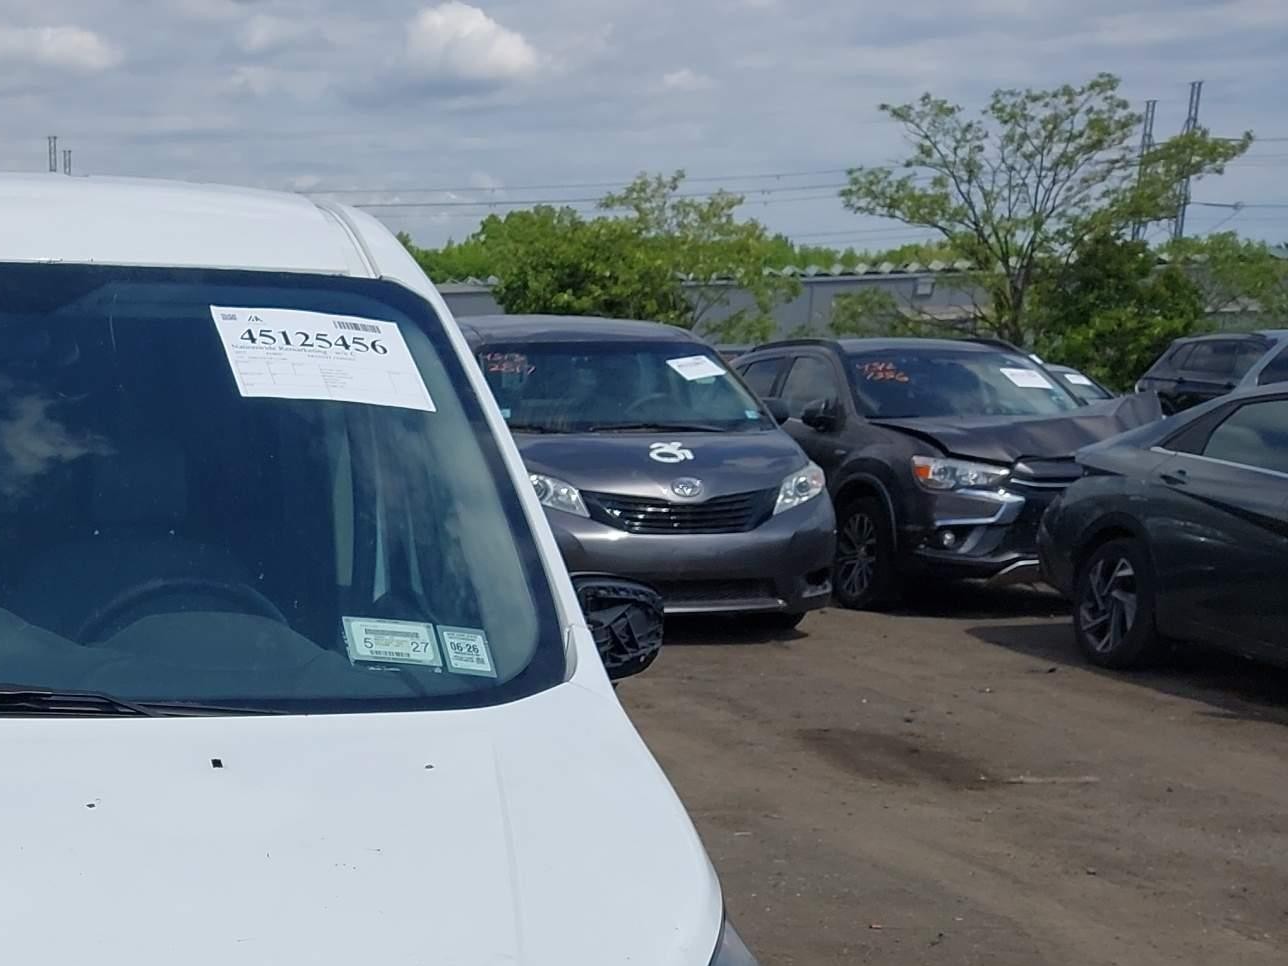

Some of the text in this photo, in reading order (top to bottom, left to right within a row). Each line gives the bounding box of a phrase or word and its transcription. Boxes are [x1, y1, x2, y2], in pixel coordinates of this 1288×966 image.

[240, 328, 388, 355] 45125456
[364, 637, 374, 649] 5
[410, 641, 429, 653] 27
